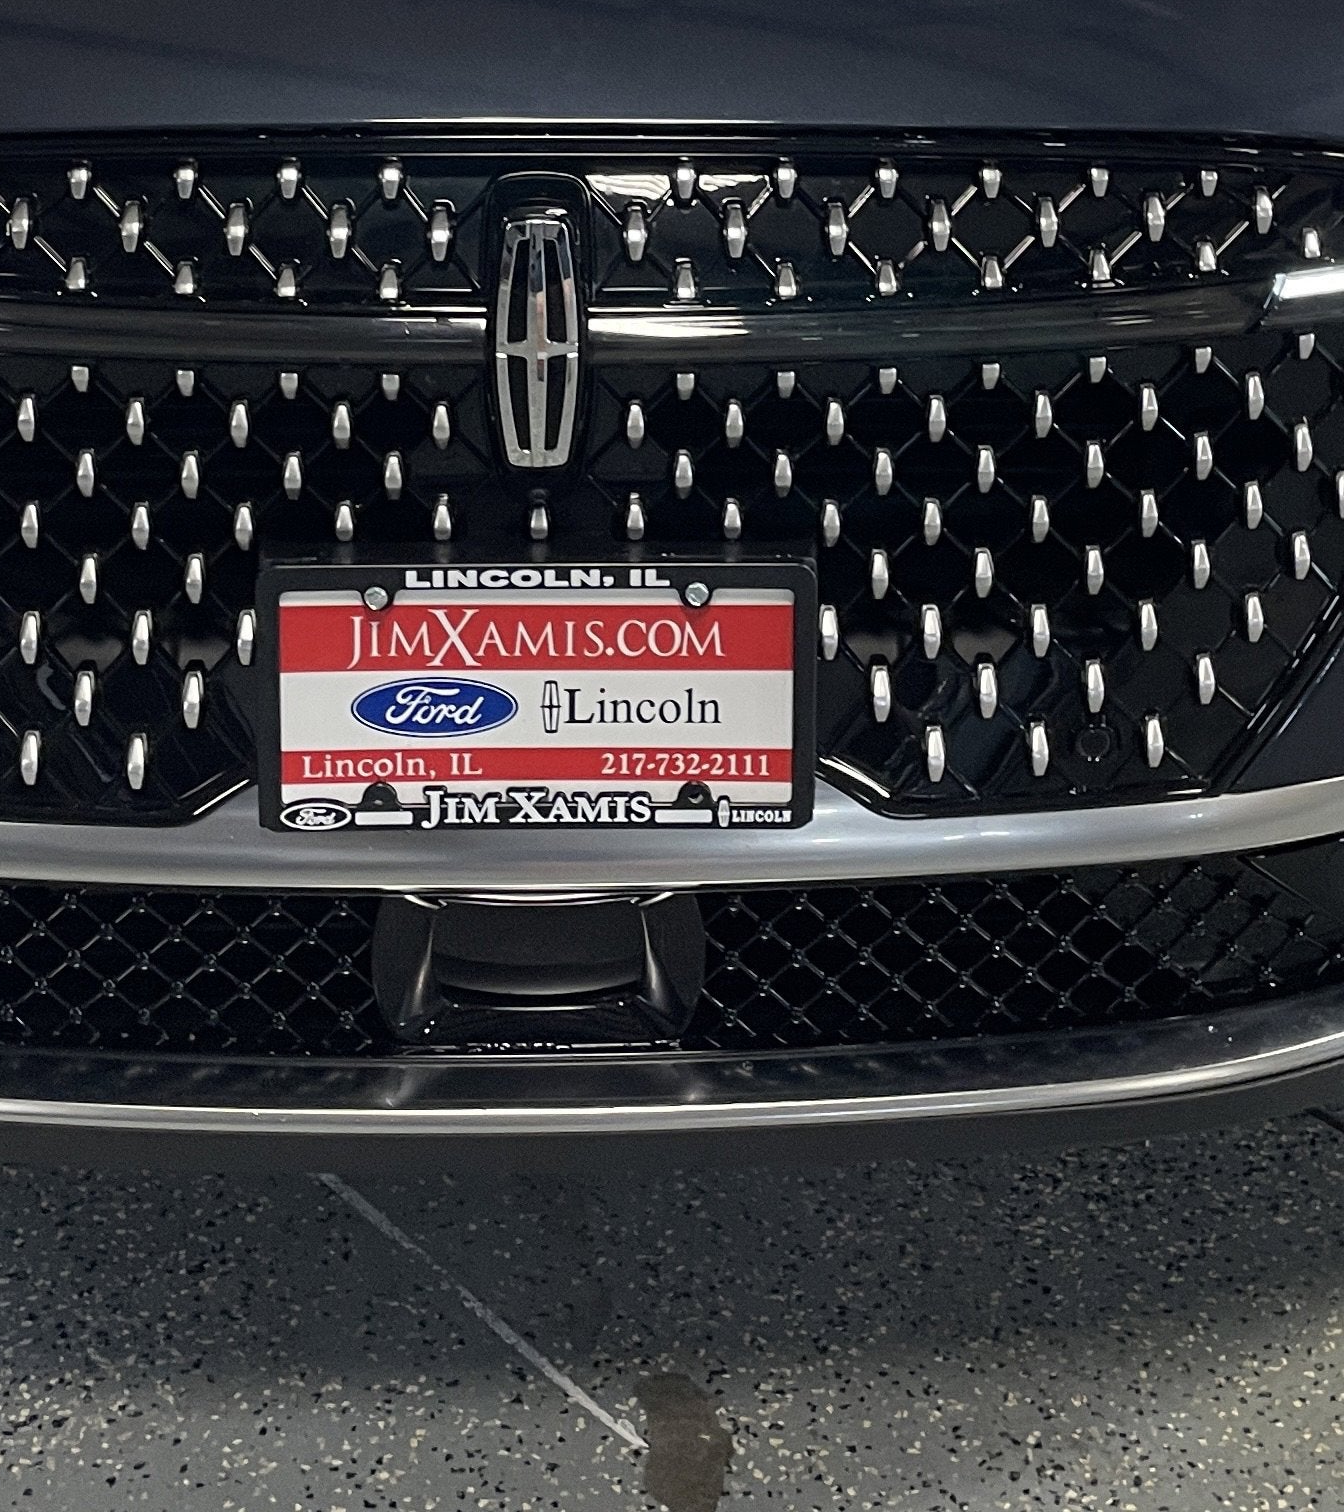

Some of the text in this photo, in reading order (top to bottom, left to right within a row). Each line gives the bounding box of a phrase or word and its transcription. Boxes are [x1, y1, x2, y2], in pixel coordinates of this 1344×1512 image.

[405, 568, 671, 589] LINCOLN, IL
[346, 607, 726, 671] JIMXAMIS.COM
[384, 685, 484, 726] Ford
[563, 687, 722, 725] Lincoln
[301, 751, 484, 780] Lincoln, IL
[600, 752, 771, 777] 217-732-2111
[421, 790, 652, 829] JIM XAMIS
[731, 809, 793, 823] LINCOLN
